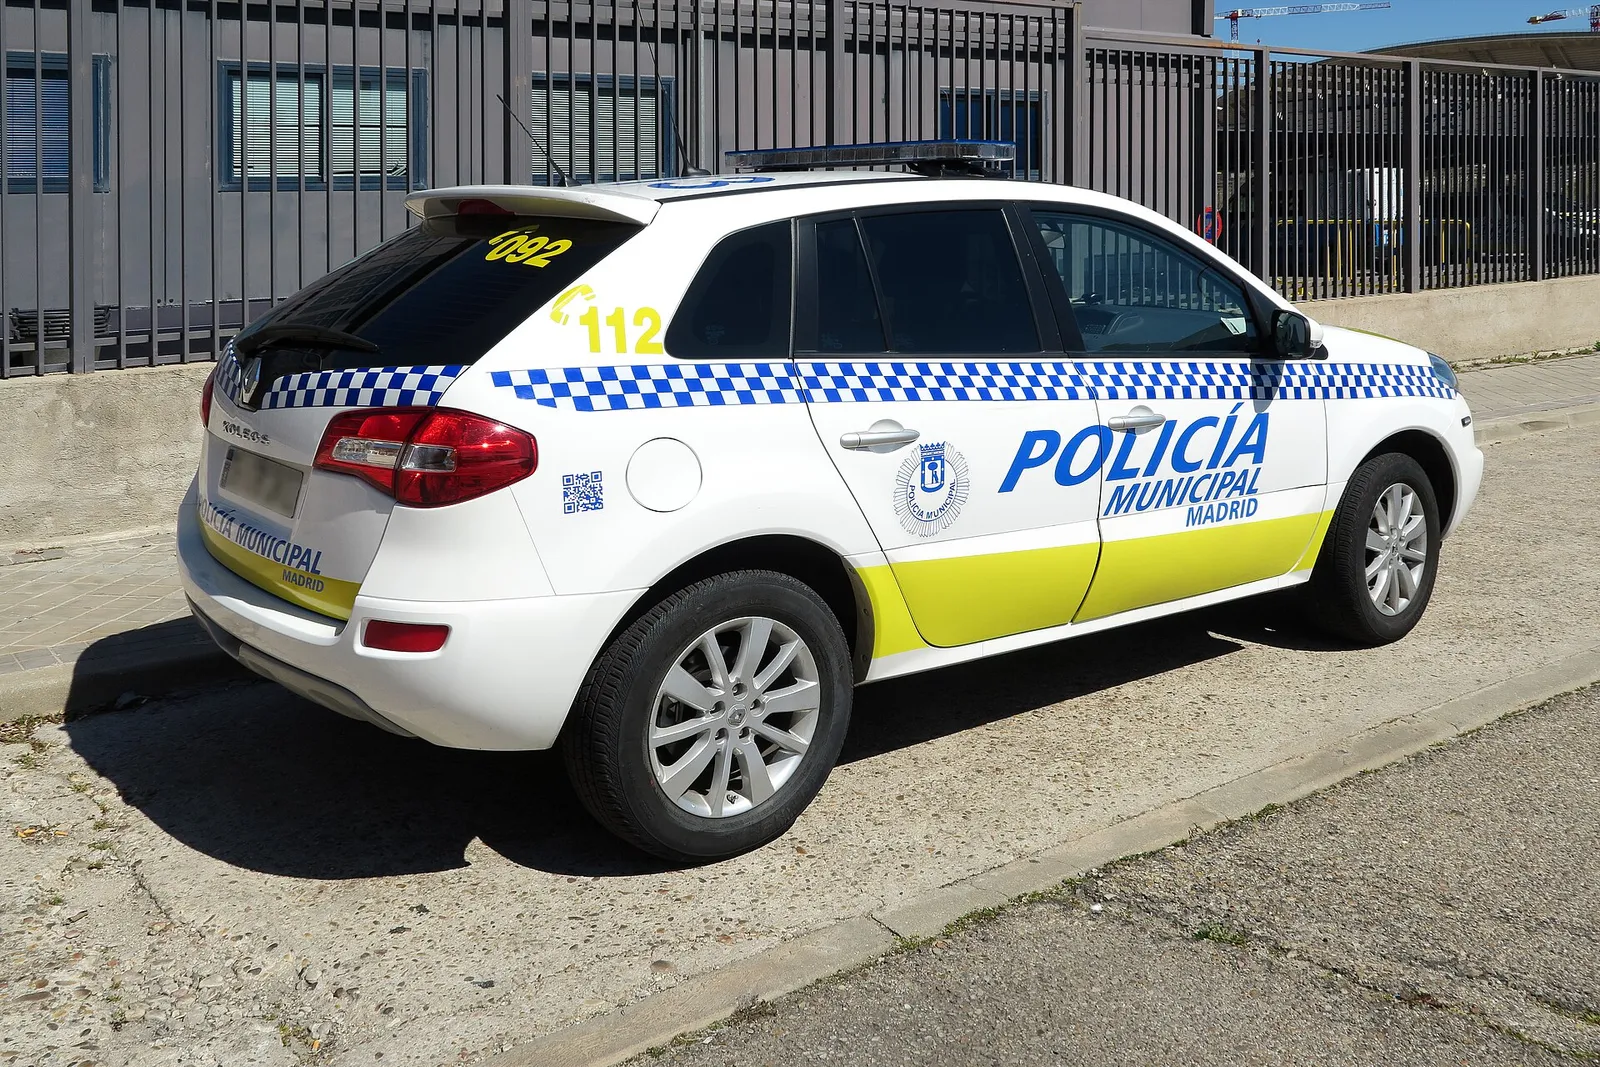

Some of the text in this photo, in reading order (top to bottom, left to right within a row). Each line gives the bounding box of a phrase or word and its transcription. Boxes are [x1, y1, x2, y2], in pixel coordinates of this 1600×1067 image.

[485, 234, 573, 268] 092
[579, 305, 664, 354] 112
[222, 420, 270, 446] KOLEOS
[997, 401, 1270, 494] POLICÍA
[925, 478, 956, 519] MUNICIPAL
[1103, 467, 1260, 517] MUNICIPAL
[1185, 497, 1259, 527] MADRID
[235, 522, 323, 576] MUNICIPAL
[282, 568, 325, 593] MADRID
